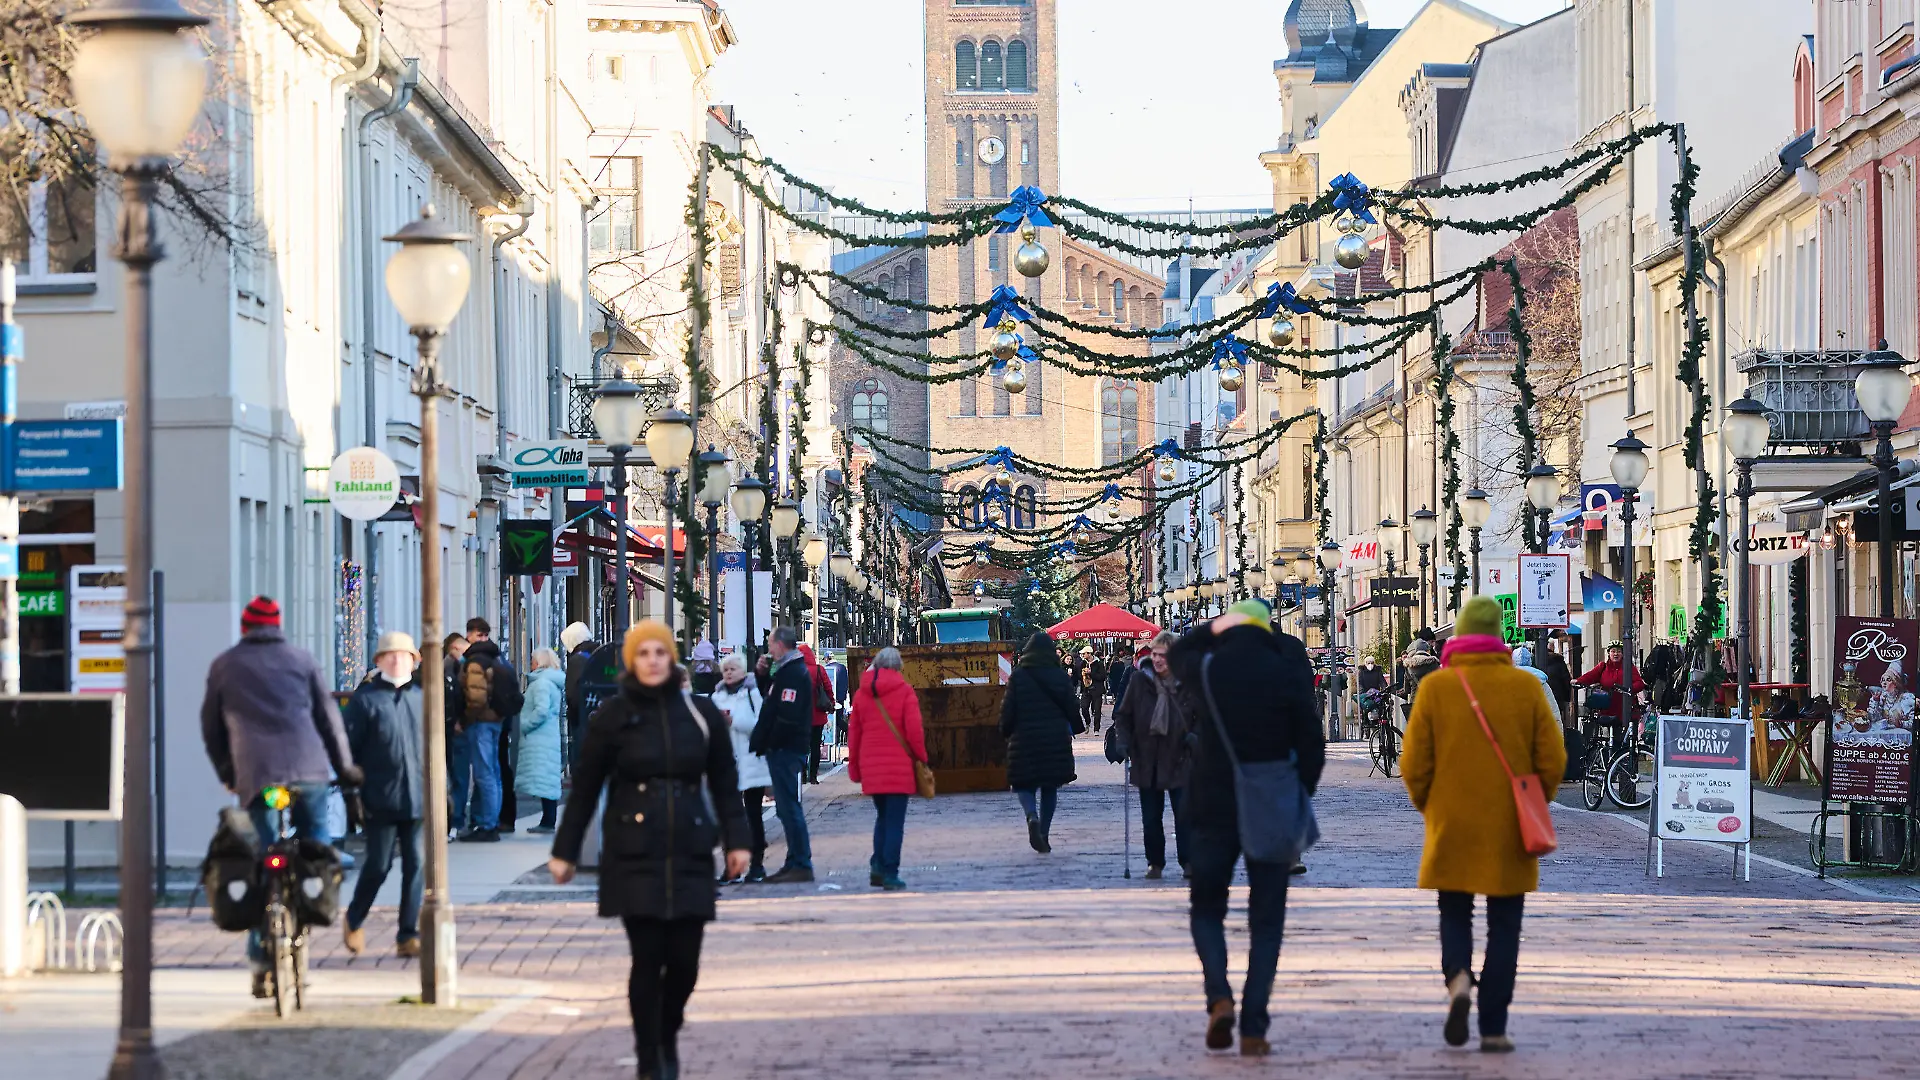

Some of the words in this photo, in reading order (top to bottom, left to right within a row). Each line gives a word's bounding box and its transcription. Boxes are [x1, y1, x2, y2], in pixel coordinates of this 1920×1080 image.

[516, 474, 584, 484] Immobilien
[335, 481, 392, 492] Fahland
[1350, 542, 1377, 559] H&M
[18, 591, 56, 611] CAFÉ
[1689, 727, 1717, 740] DOGS
[1677, 738, 1730, 754] COMPANY
[1833, 750, 1865, 758] SUPPE
[1882, 752, 1900, 760] 4,00
